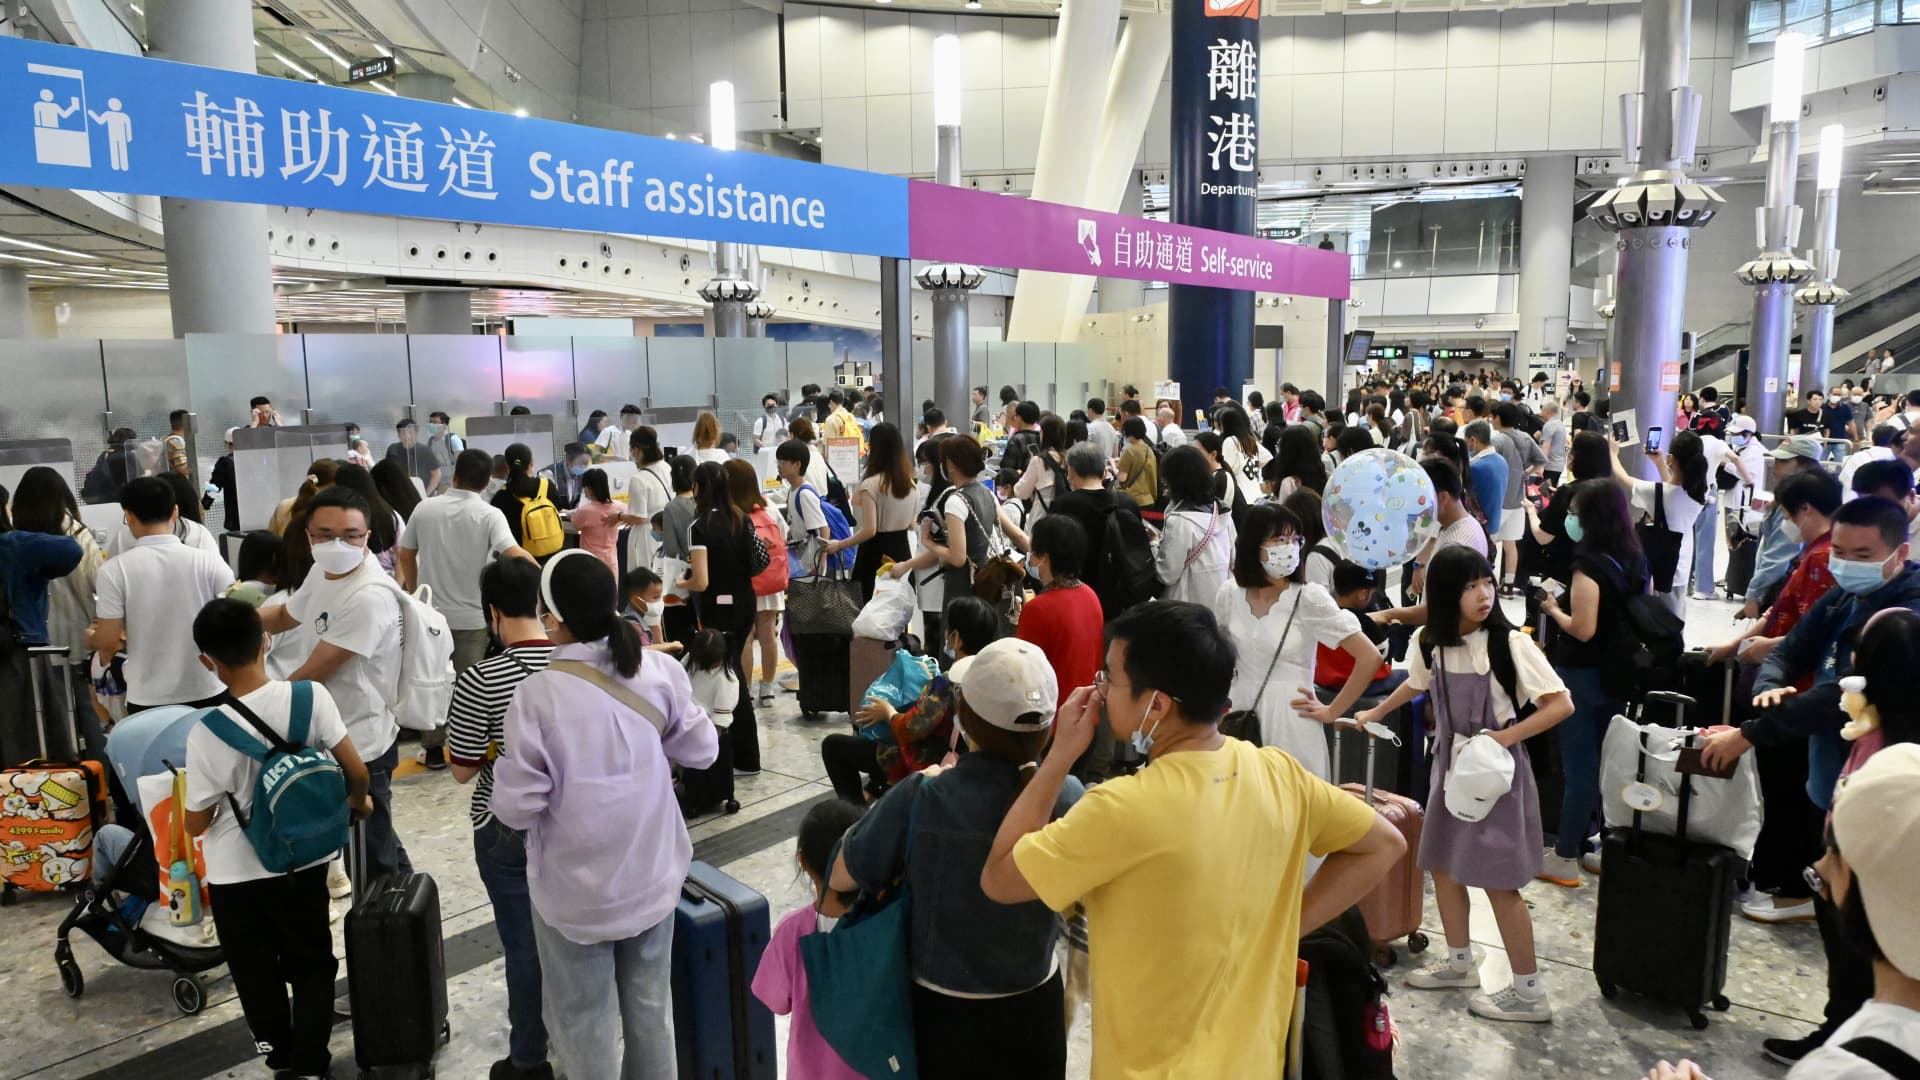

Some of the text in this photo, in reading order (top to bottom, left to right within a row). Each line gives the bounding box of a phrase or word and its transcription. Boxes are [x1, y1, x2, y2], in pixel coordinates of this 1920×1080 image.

[1207, 38, 1257, 172] 離港
[181, 90, 498, 200] 輔助通道
[528, 151, 826, 229] Staff assistance
[1114, 226, 1193, 273] 自助通道
[1200, 246, 1273, 280] Self-service
